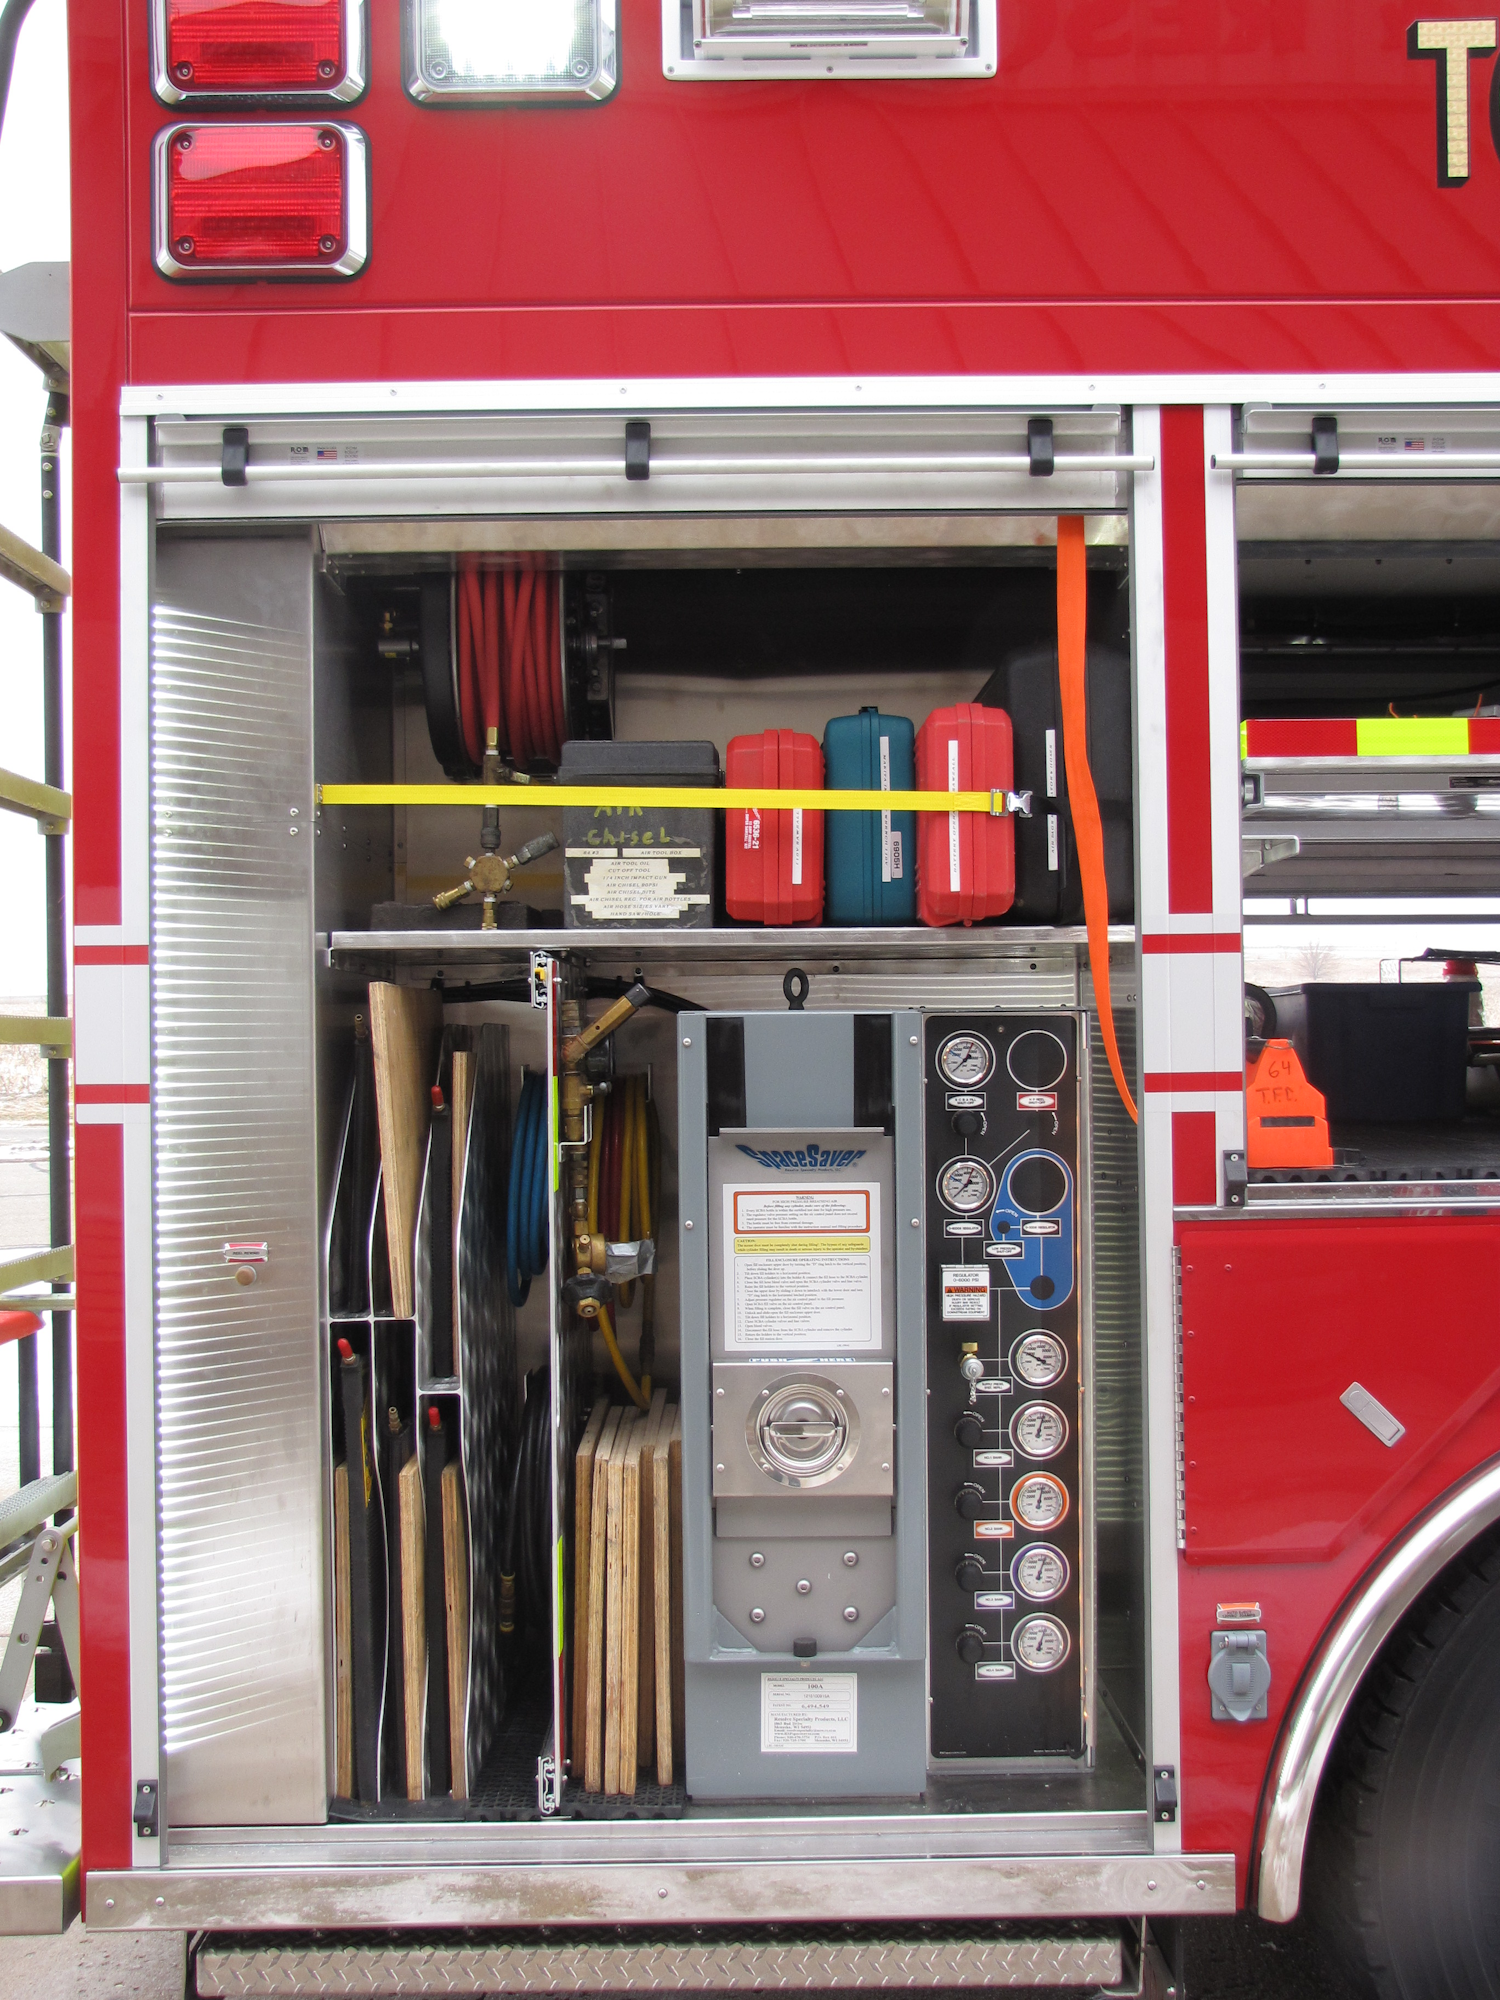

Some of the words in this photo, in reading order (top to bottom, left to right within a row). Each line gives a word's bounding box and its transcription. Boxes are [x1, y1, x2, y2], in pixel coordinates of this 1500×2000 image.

[1406, 18, 1500, 187] T
[752, 819, 760, 849] 6536-21
[1268, 1060, 1291, 1078] 64
[980, 1121, 988, 1136] OPEN
[735, 1144, 867, 1170] SpaceSaver
[1004, 1208, 1018, 1218] OPEN
[973, 1411, 985, 1423] OPEN
[973, 1482, 986, 1494] OPEN
[973, 1553, 986, 1564] OPEN
[974, 1624, 987, 1636] OPEN
